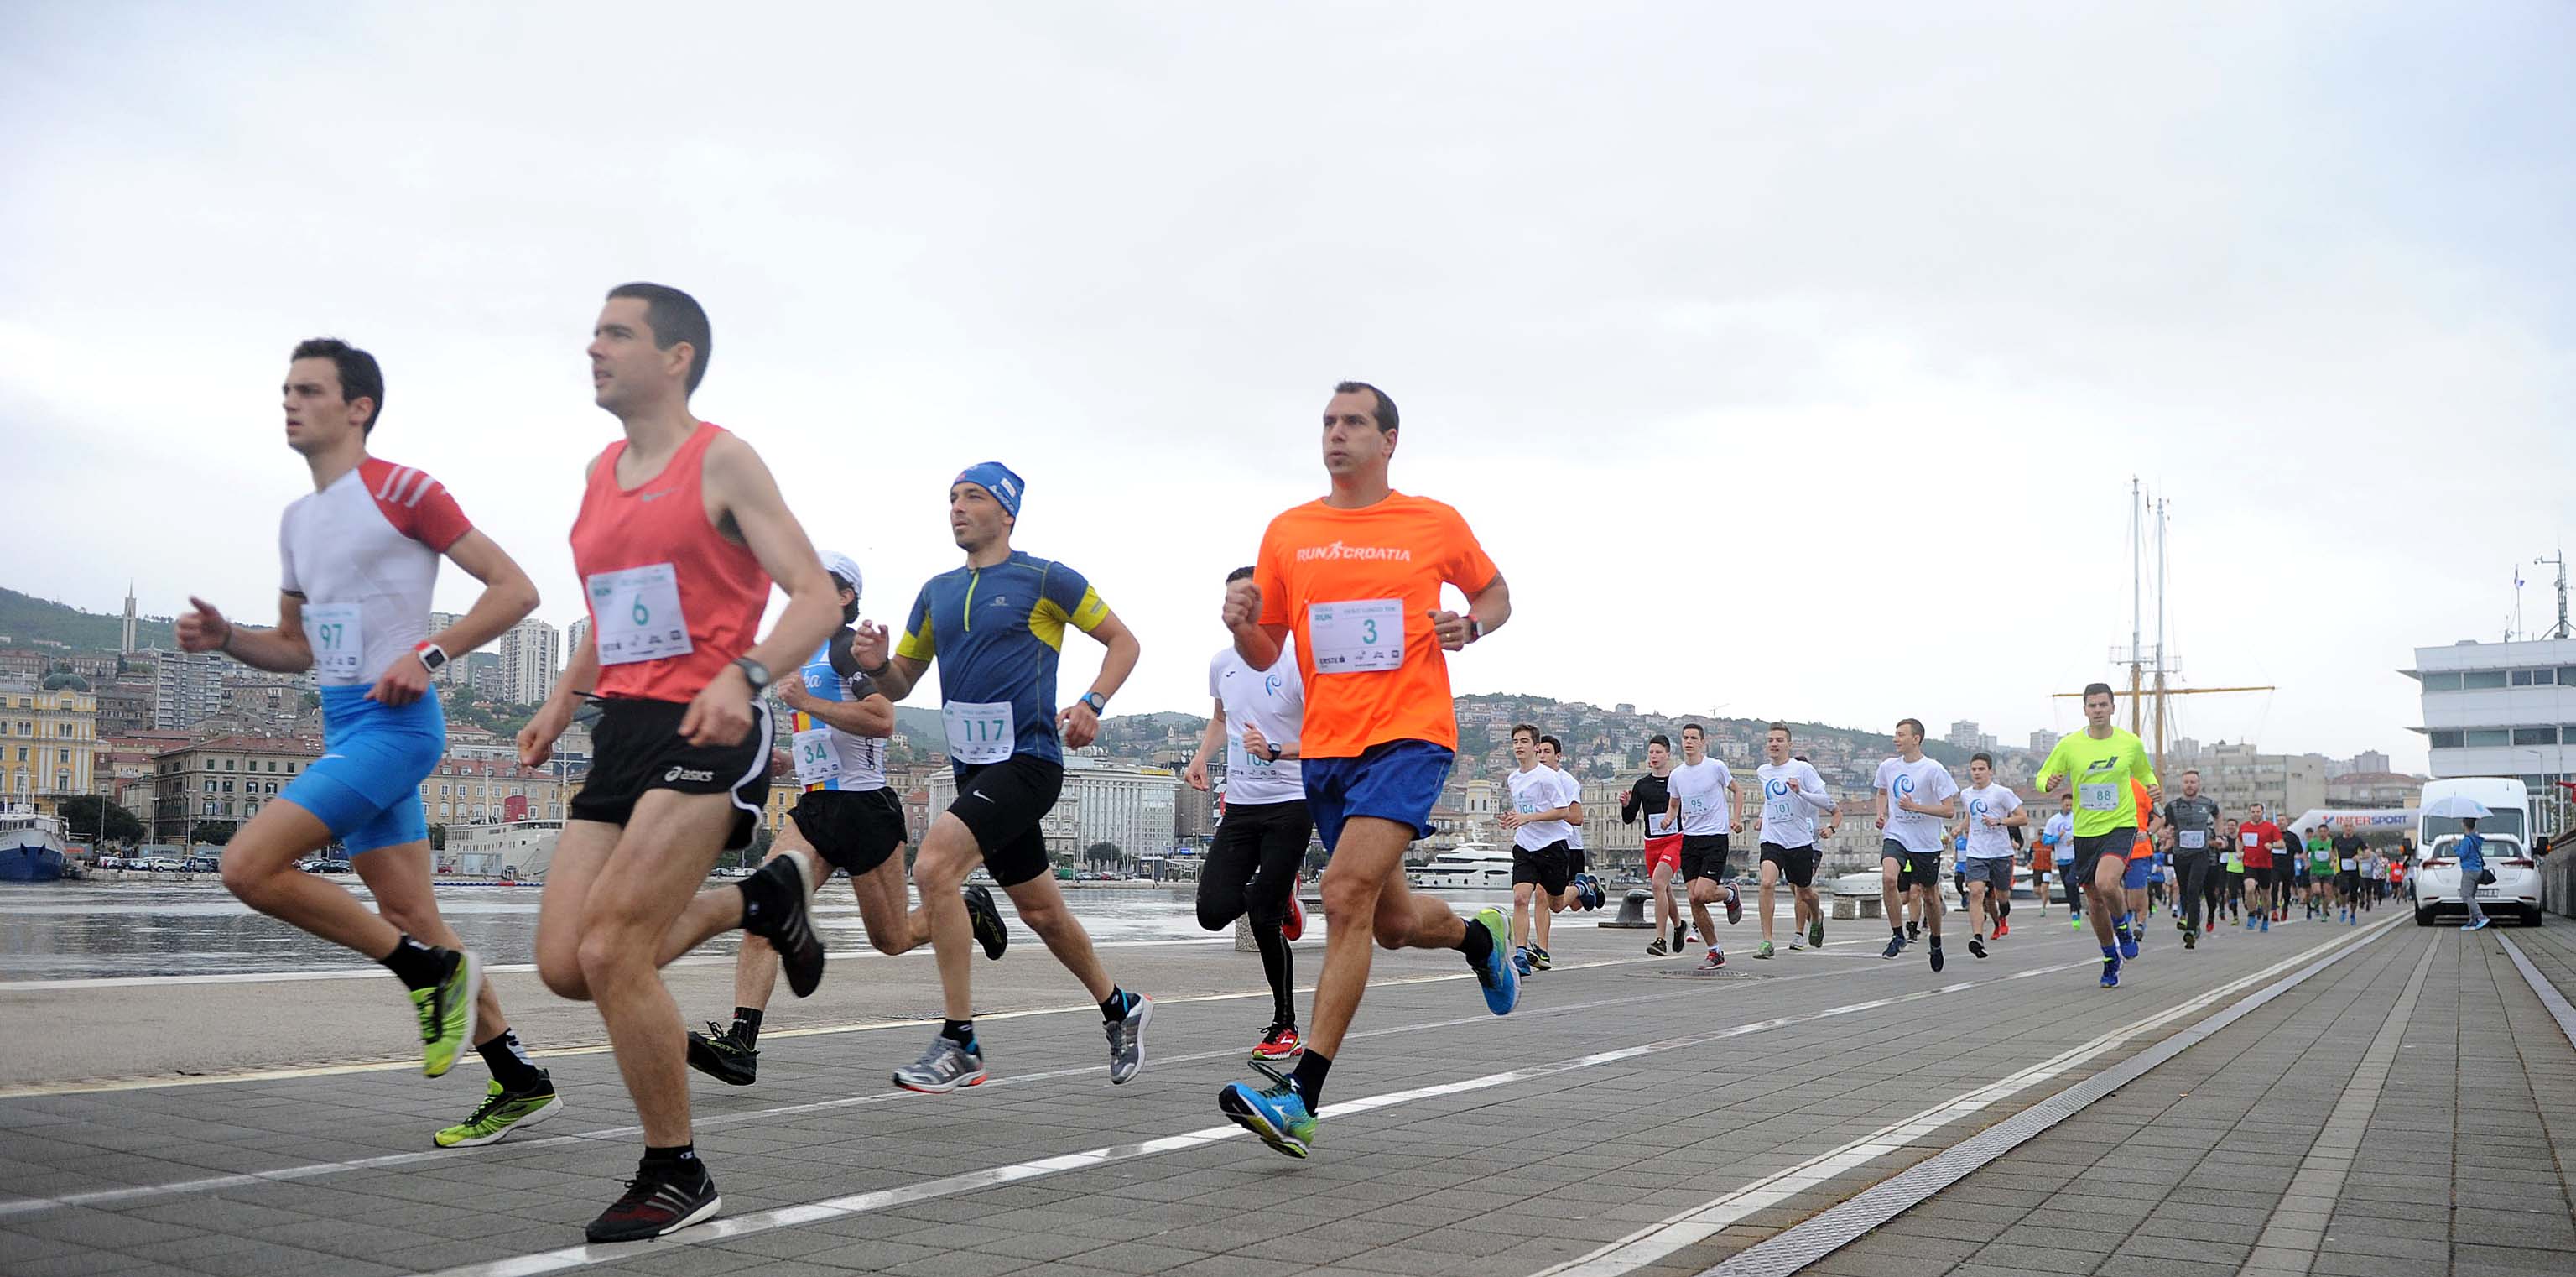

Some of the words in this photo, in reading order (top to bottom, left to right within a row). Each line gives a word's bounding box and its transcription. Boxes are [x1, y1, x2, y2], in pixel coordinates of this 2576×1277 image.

[1297, 546, 1327, 561] RUN
[1342, 546, 1411, 561] CROATIA
[632, 594, 649, 626] 6
[320, 623, 343, 649] 97
[1362, 618, 1378, 644] 3
[963, 719, 1005, 742] 117
[804, 743, 827, 764] 34
[2097, 790, 2111, 800] 88
[1519, 805, 1533, 813] 104
[1691, 799, 1702, 807] 95
[1775, 803, 1790, 813] 101
[2336, 816, 2408, 826] INTERSPORT
